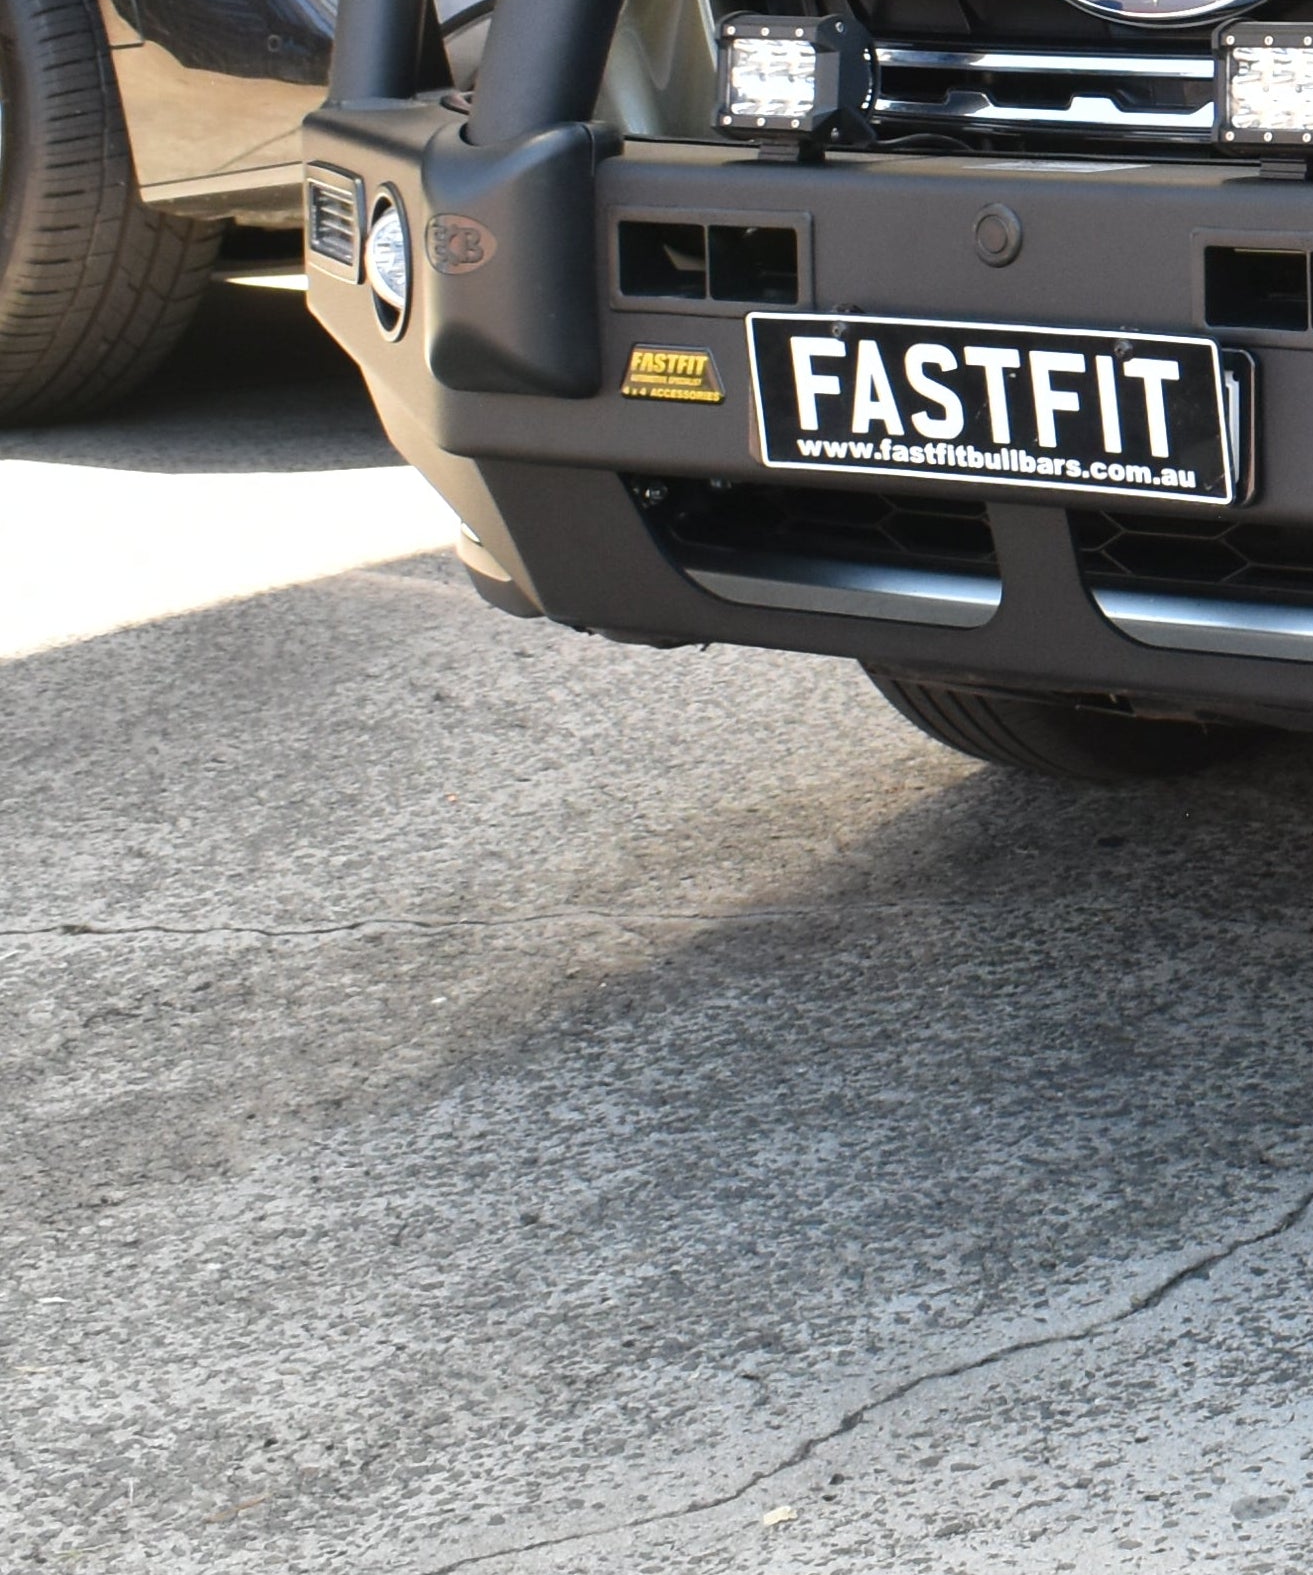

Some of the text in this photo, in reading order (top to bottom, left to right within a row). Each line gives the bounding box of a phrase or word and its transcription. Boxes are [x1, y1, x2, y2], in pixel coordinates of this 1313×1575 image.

[630, 351, 709, 376] FASTFIT
[649, 388, 721, 402] ACCESSORIES
[789, 336, 1180, 458] FASTFIT
[797, 437, 1197, 489] www.fastfitbullbars.com.au
